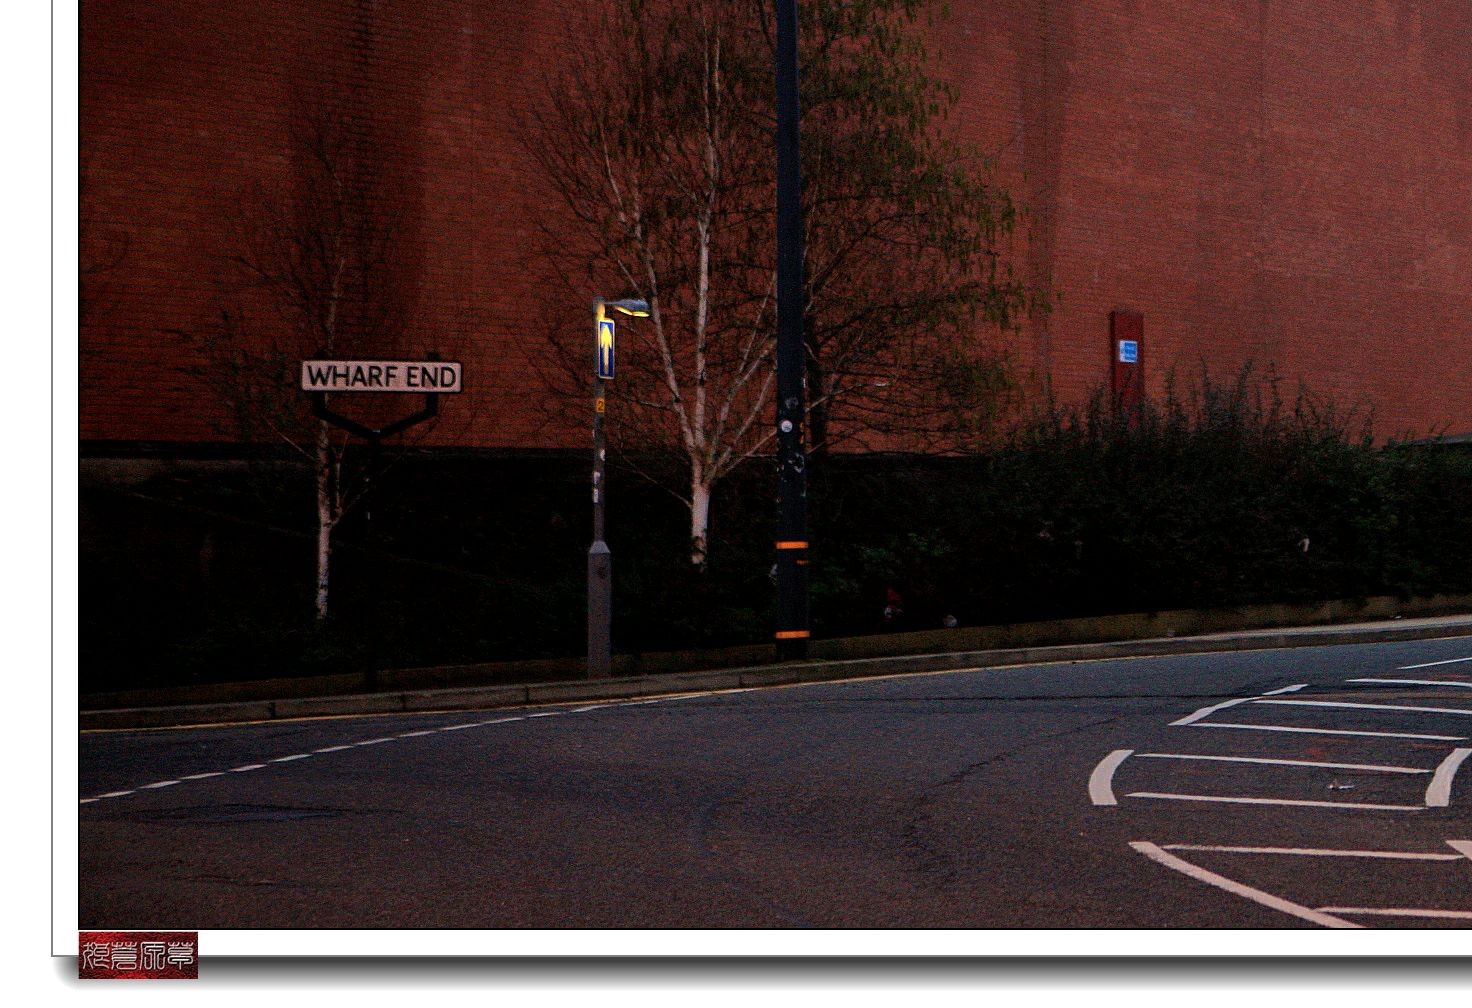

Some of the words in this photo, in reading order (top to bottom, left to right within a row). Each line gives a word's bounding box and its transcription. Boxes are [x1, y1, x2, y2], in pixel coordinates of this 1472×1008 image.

[307, 365, 398, 387] WHARF
[407, 367, 456, 388] END
[597, 400, 604, 411] 2
